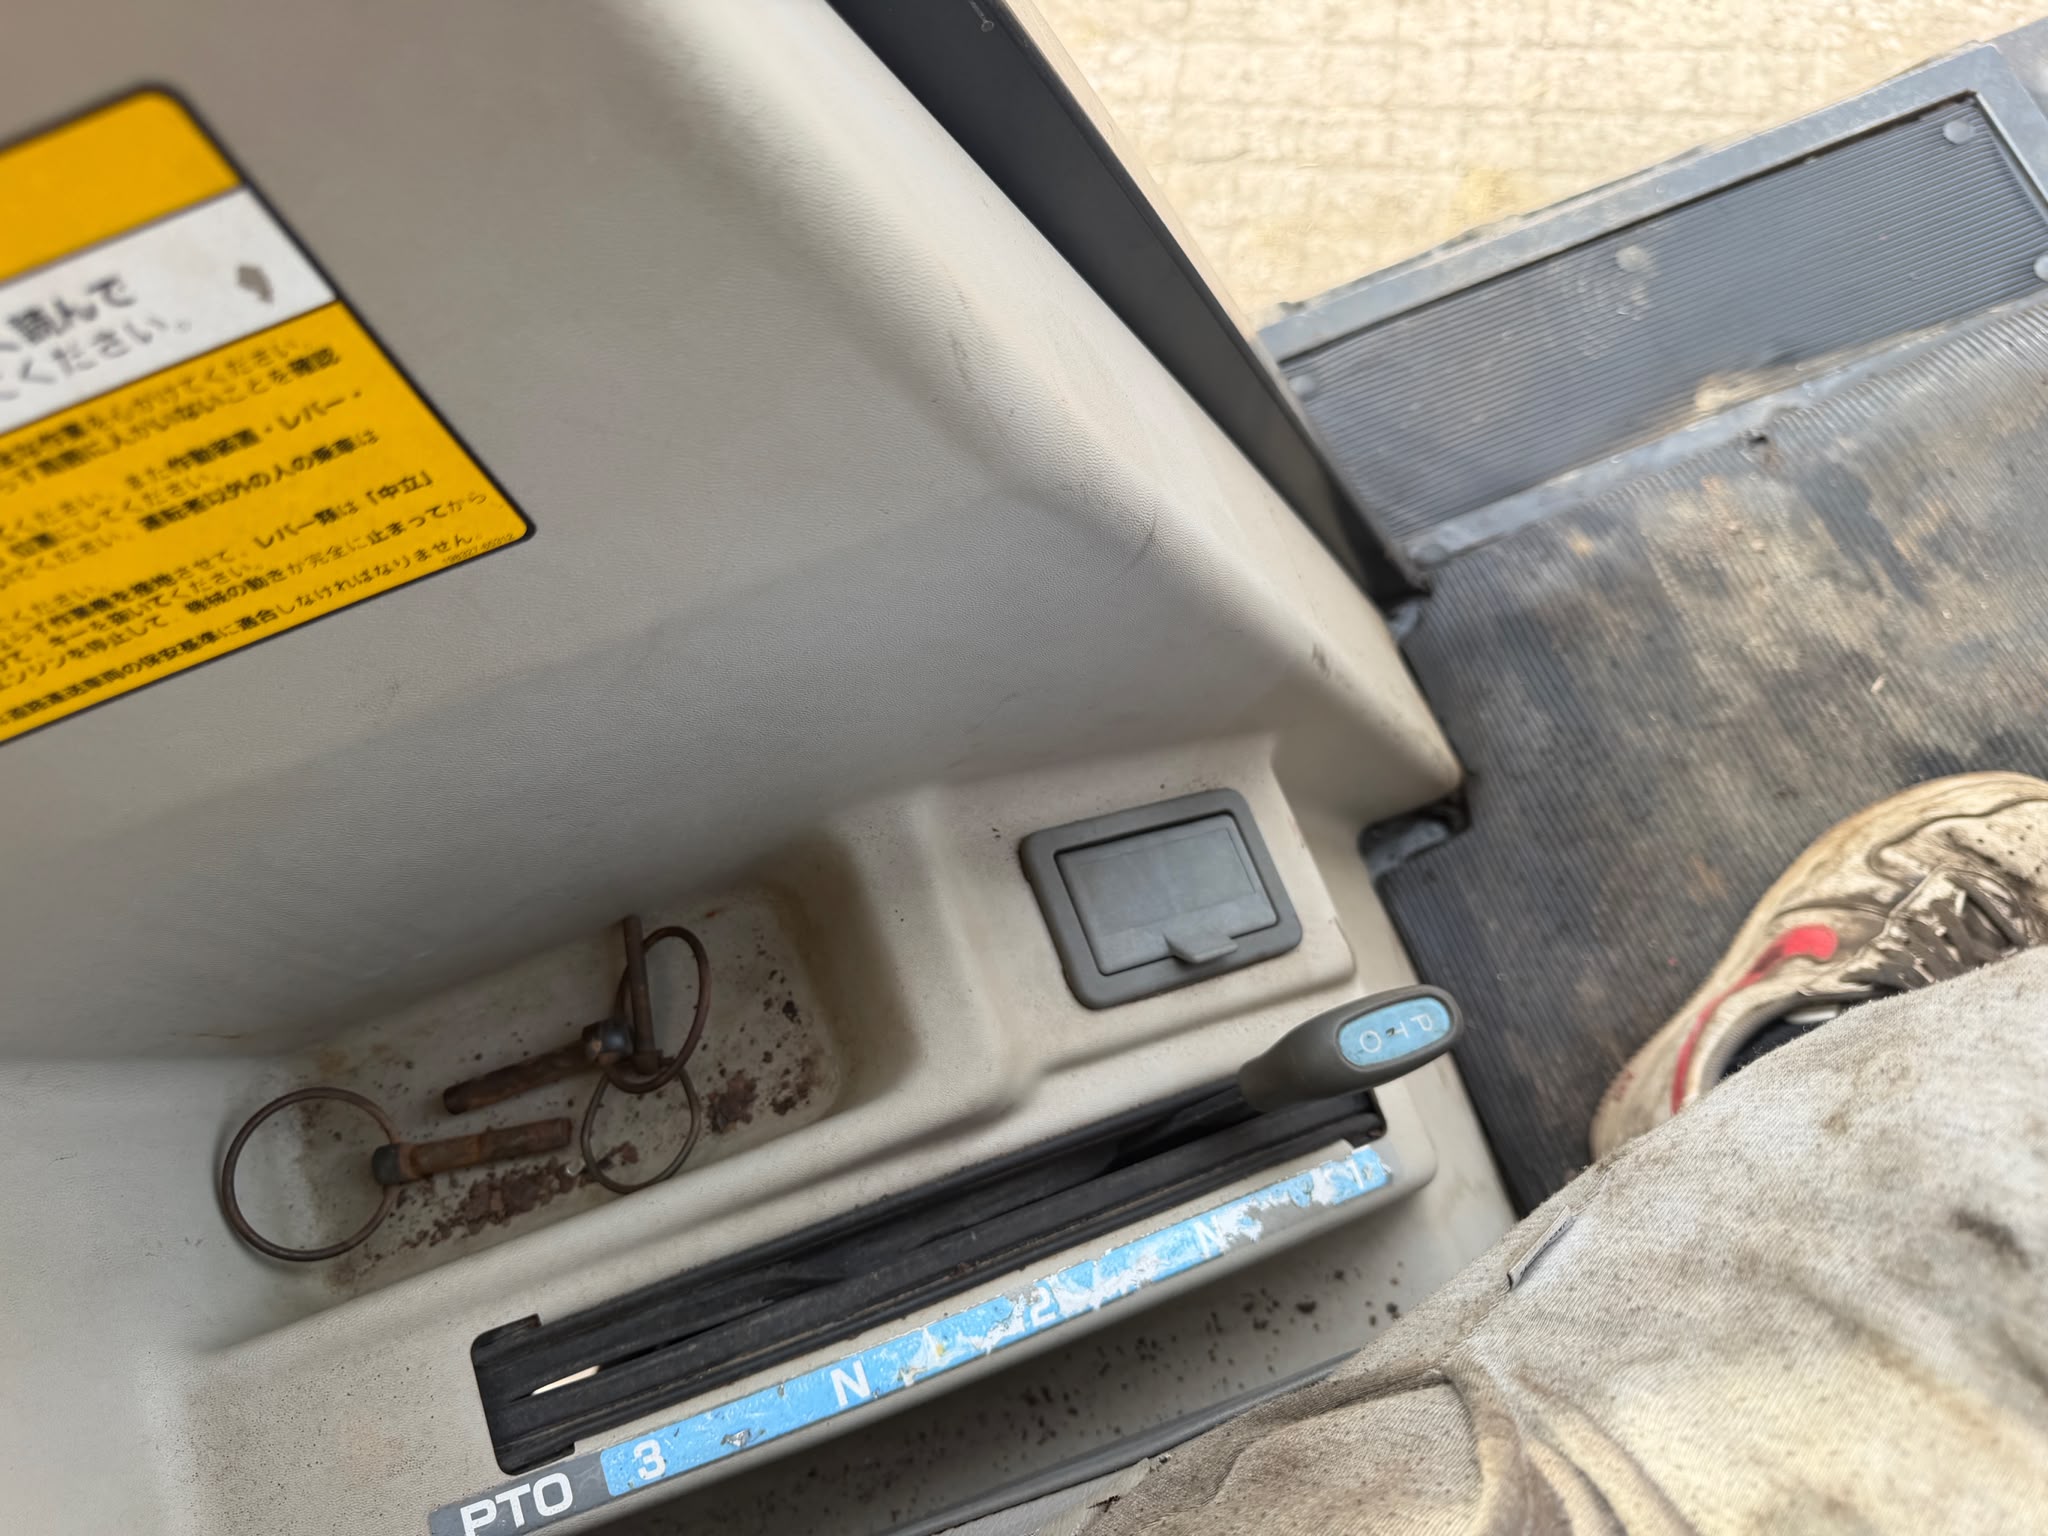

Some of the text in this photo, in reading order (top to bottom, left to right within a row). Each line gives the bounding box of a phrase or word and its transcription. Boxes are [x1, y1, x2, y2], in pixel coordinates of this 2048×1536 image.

[460, 1473, 573, 1536] PTO
[633, 1439, 667, 1481] 3
[831, 1361, 871, 1407] N
[1030, 1286, 1057, 1326] 2
[1193, 1214, 1230, 1258] N
